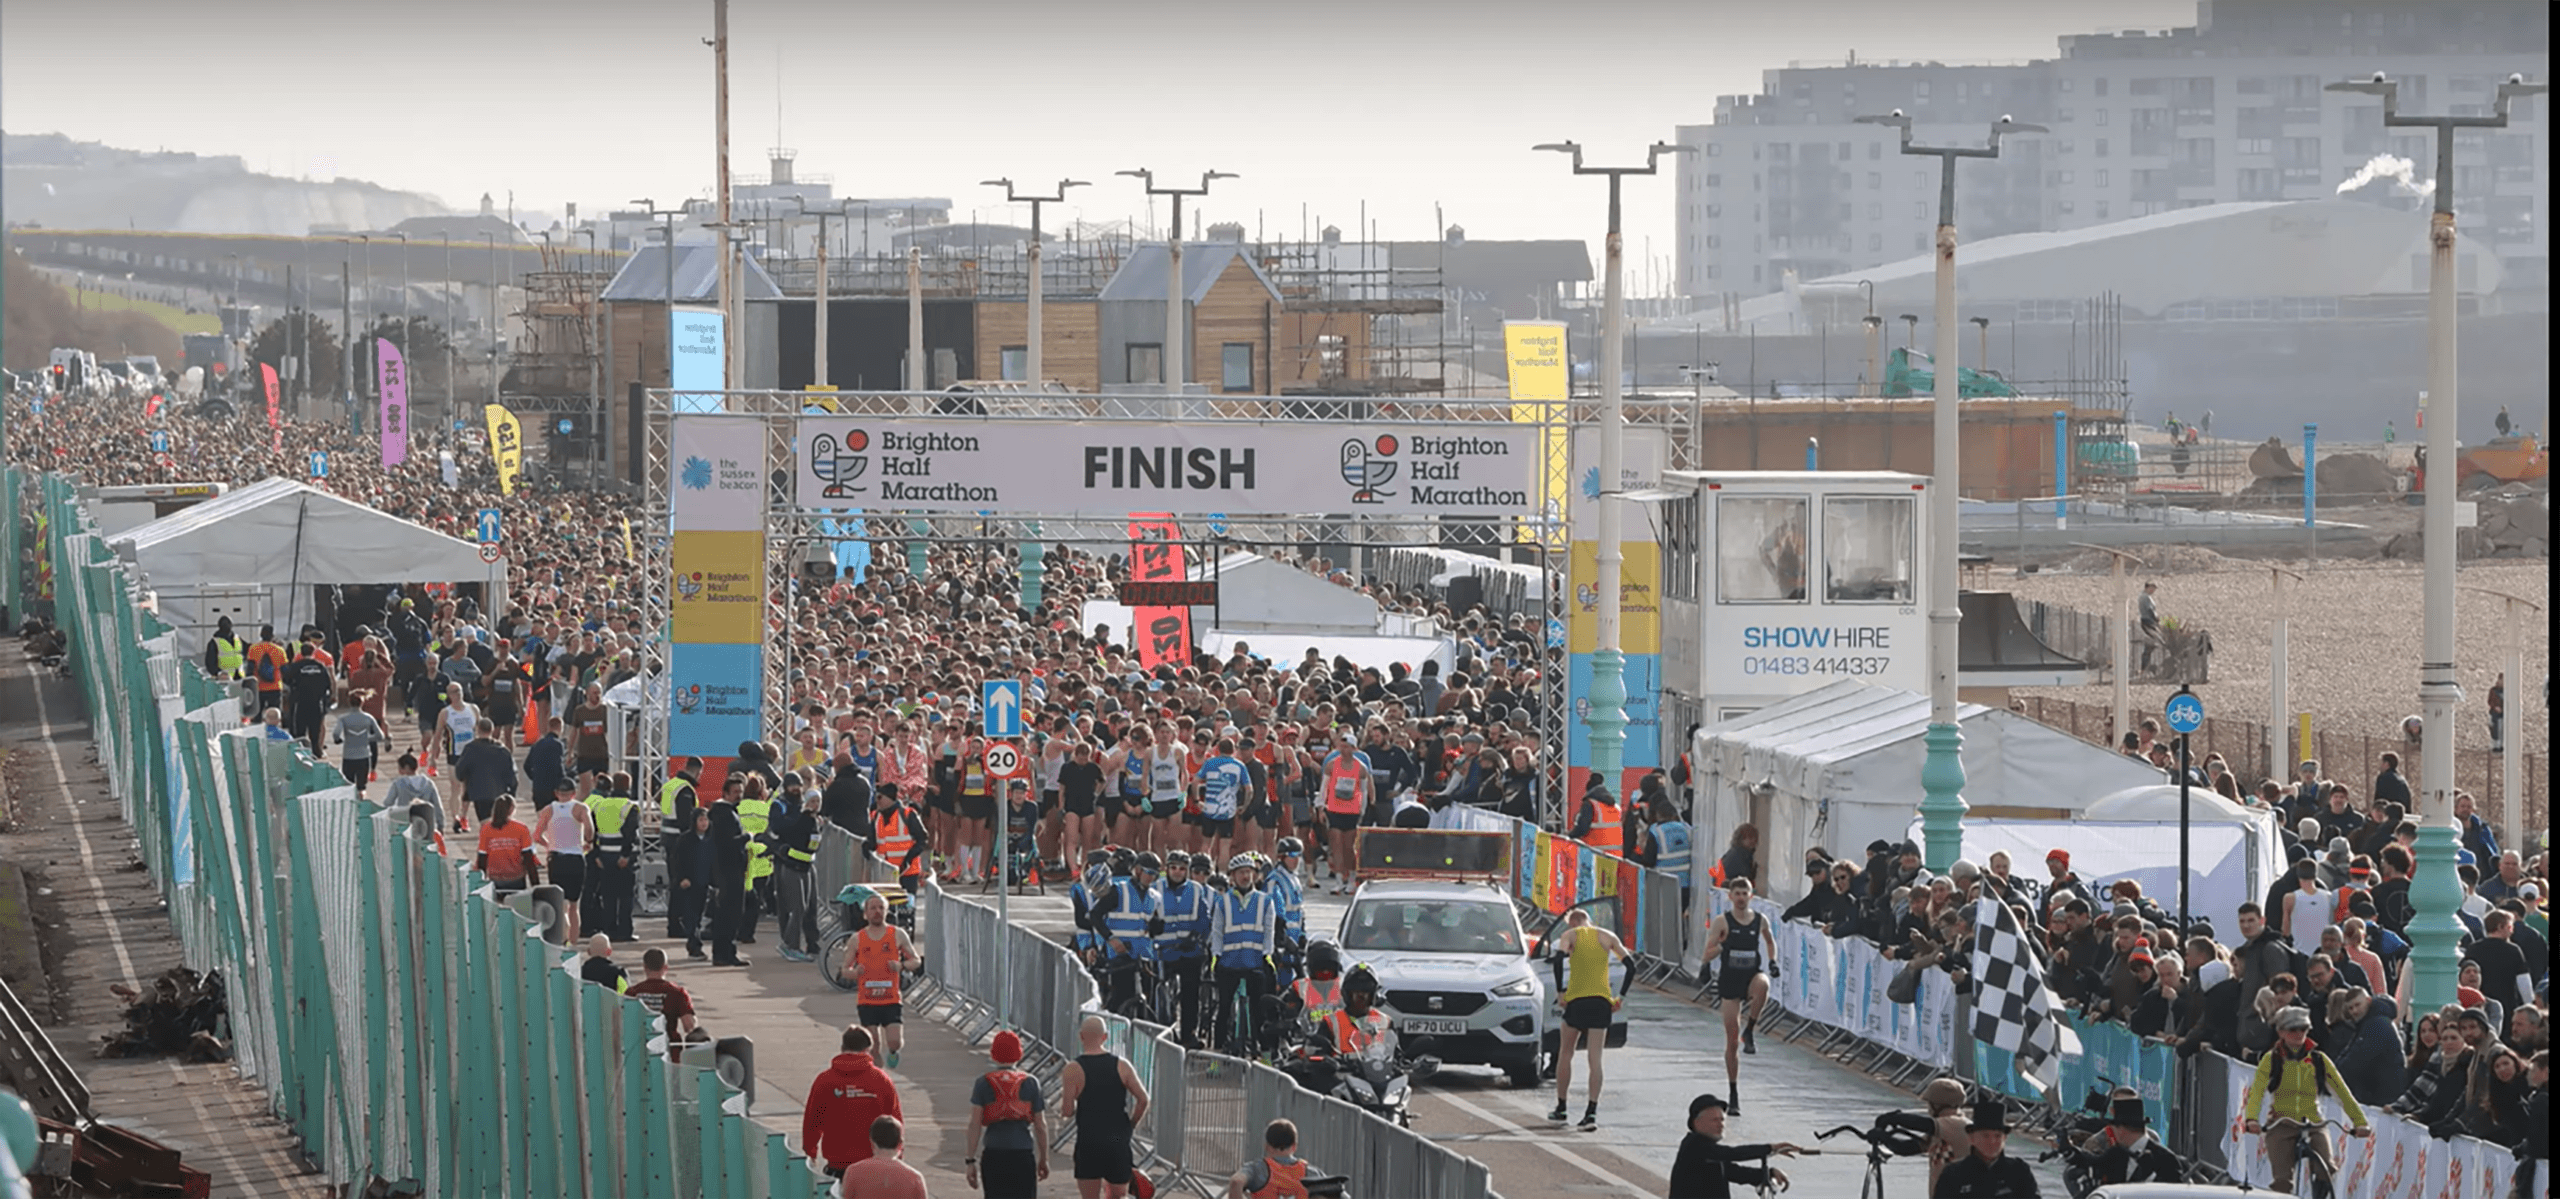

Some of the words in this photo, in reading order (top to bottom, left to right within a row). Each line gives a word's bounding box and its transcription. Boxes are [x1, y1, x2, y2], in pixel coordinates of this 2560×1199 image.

[881, 432, 979, 455] Brighton
[1411, 436, 1509, 460] Brighton
[719, 458, 738, 469] the
[881, 457, 931, 476] Half
[1084, 446, 1256, 490] FINISH
[1411, 462, 1460, 480] Half
[719, 470, 756, 479] sussex
[1621, 469, 1639, 480] the
[719, 480, 758, 490] beacon
[881, 482, 998, 502] Marathon
[1620, 481, 1657, 490] sussex
[1411, 487, 1527, 506] Marathon
[483, 547, 498, 557] 20
[1744, 627, 1830, 648] SHOW
[1834, 627, 1890, 648] HIRE
[1744, 657, 1810, 675] 01483
[1813, 657, 1890, 675] 414337
[990, 752, 1015, 768] 20
[1407, 1022, 1437, 1033] HF70
[1440, 1023, 1462, 1033] UCU
